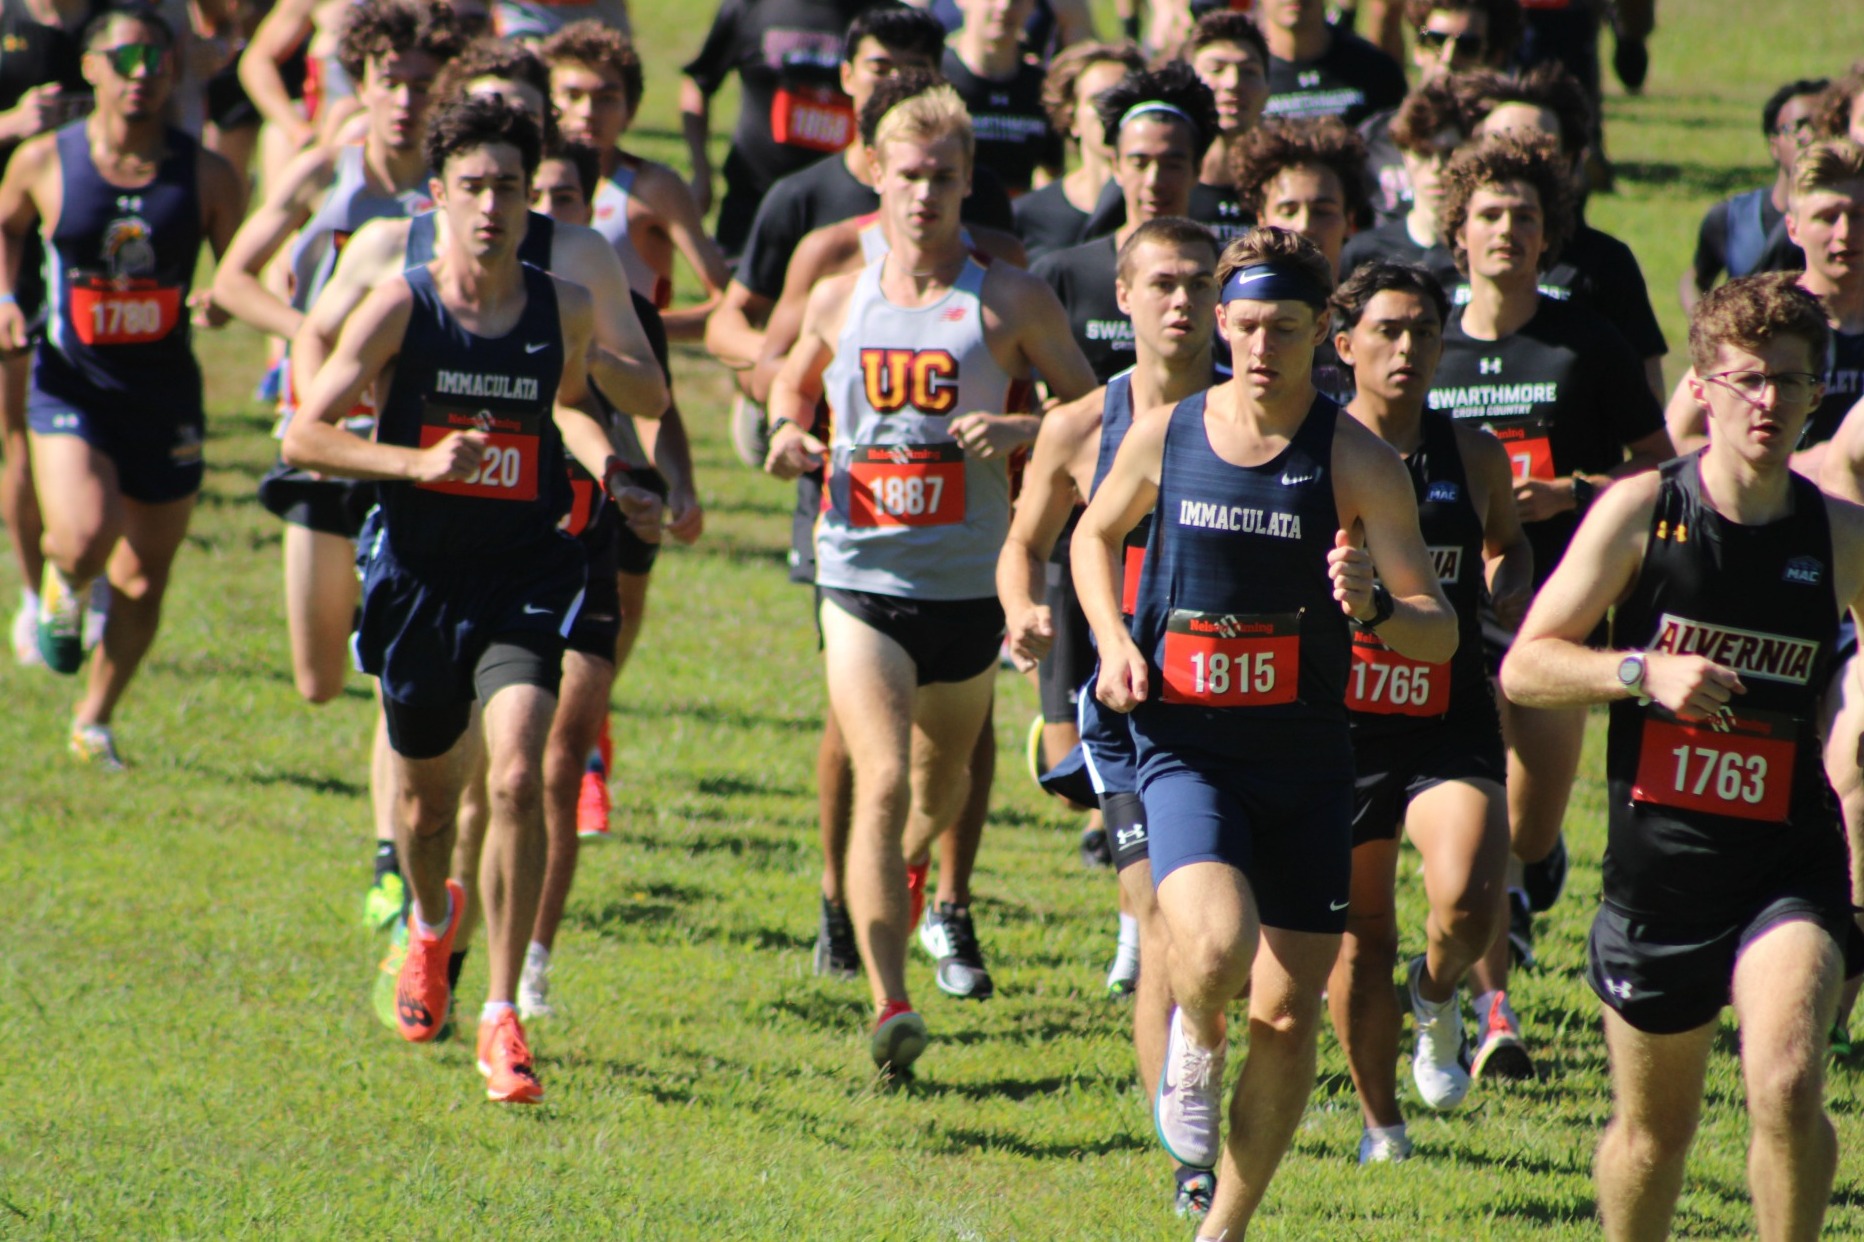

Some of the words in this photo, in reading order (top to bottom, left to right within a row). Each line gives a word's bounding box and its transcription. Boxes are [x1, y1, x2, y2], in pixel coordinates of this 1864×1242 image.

[436, 369, 539, 400] IMMACULATA
[860, 348, 959, 416] UC
[1427, 382, 1557, 410] SWARTHMORE
[1452, 406, 1485, 418] CROSS
[1486, 403, 1532, 416] COUNTRY
[868, 475, 944, 516] 1887
[1429, 490, 1456, 500] MAC
[1179, 500, 1302, 540] IMMACULATA
[1786, 567, 1821, 583] MAC
[1654, 620, 1815, 679] ALVERNIA
[1190, 651, 1275, 694] 1815
[1352, 661, 1430, 706] 1765
[1672, 744, 1768, 804] 1763
